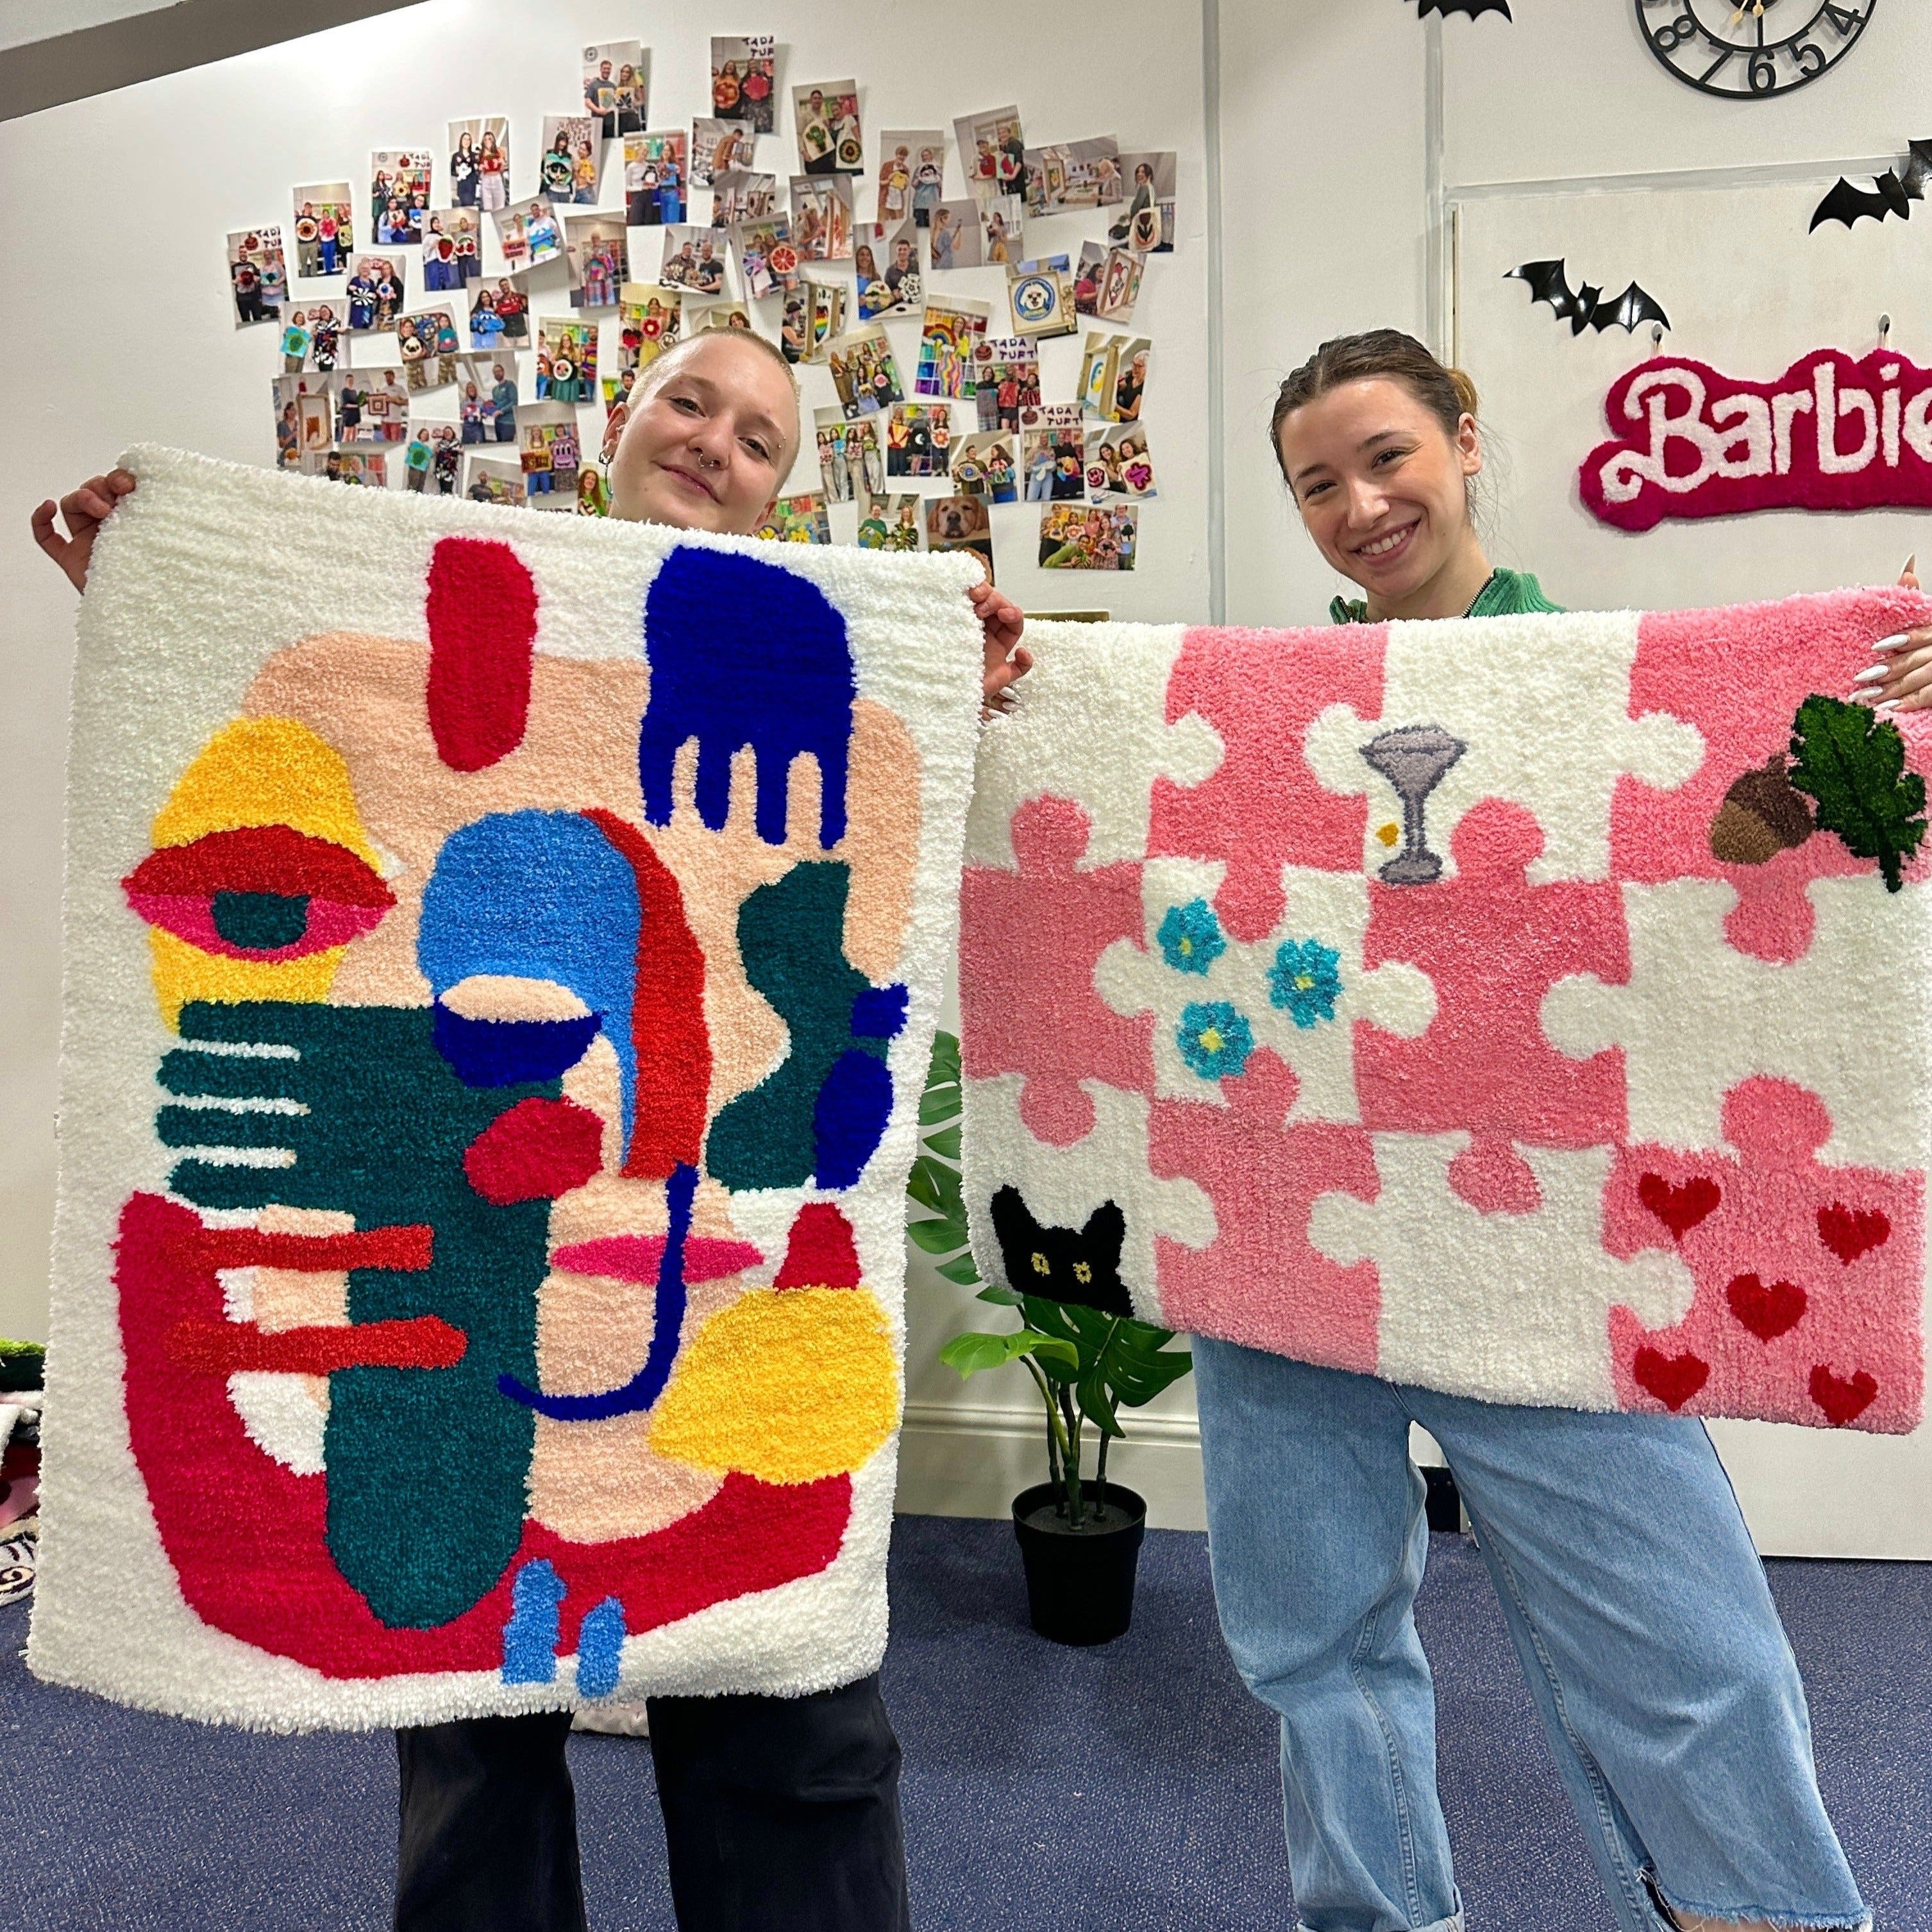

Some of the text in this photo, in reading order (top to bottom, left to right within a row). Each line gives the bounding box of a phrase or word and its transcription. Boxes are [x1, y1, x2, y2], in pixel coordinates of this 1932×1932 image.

[1654, 14, 1697, 53] 8
[1822, 3, 1867, 36] 4
[1698, 38, 1735, 85] 7
[1786, 29, 1826, 78] 5
[1748, 48, 1776, 93] 6
[989, 338, 1027, 348] TADA
[999, 350, 1034, 360] TUFT
[1039, 407, 1072, 416] TADA
[1046, 417, 1079, 426] TUFT
